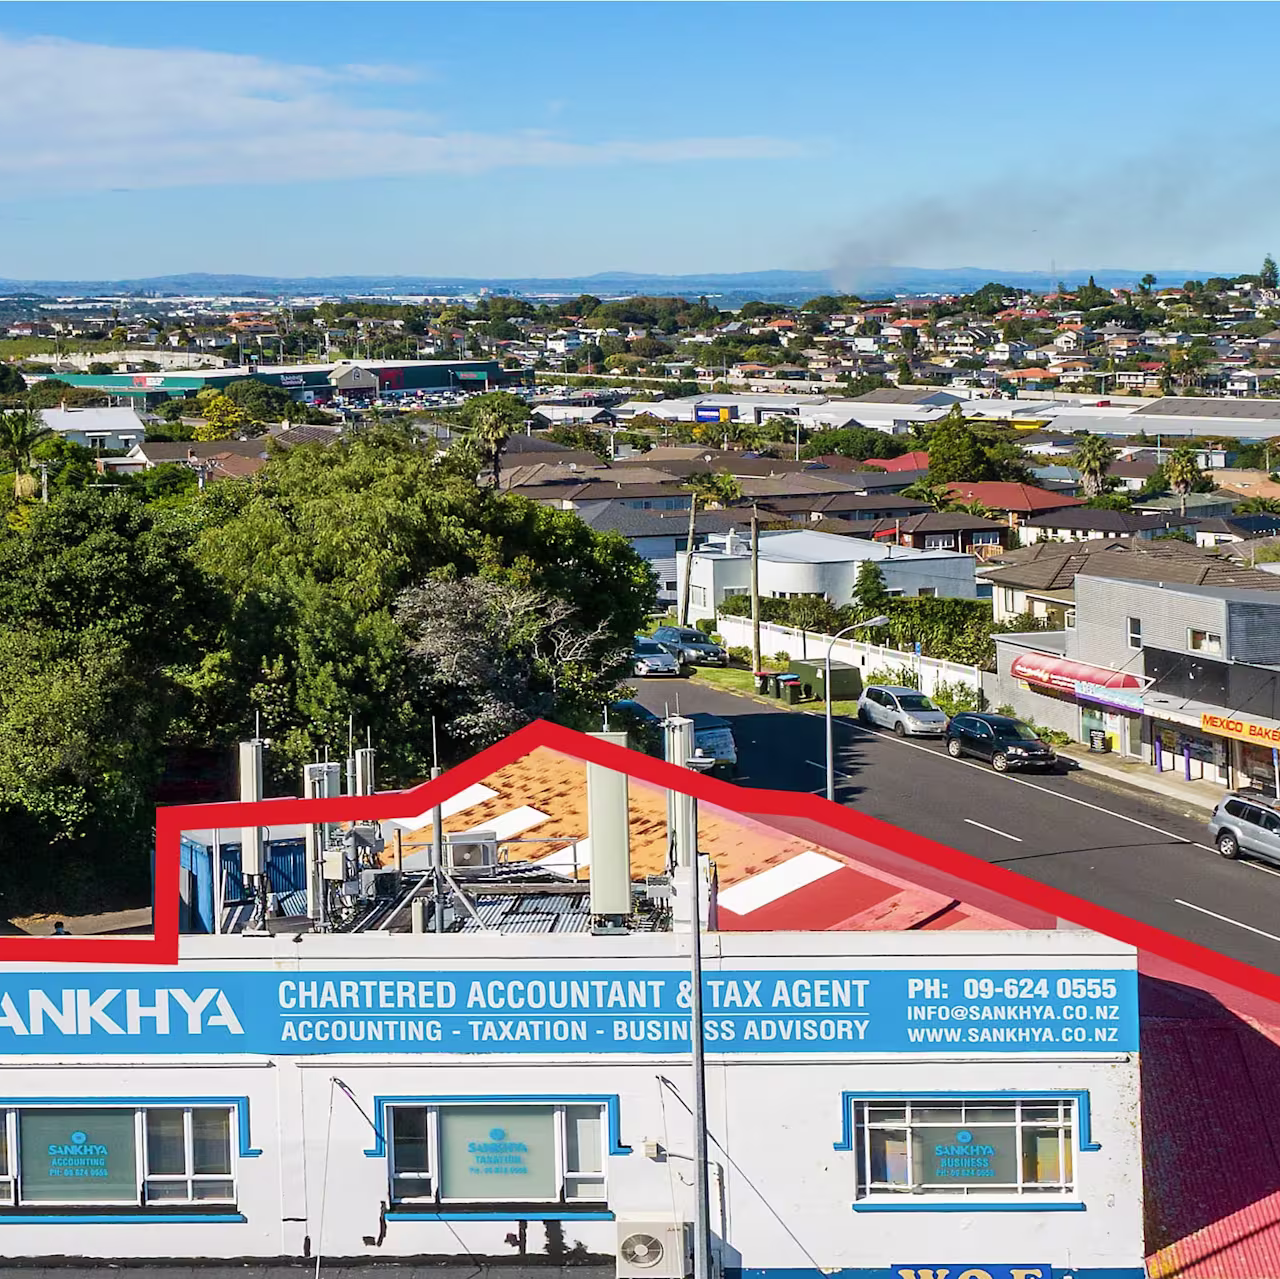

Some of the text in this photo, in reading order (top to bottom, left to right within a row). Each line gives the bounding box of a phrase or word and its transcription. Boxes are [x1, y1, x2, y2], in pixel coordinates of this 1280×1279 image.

[1202, 714, 1243, 733] MEXICO
[278, 979, 870, 1009] CHARTERED ACCOUNTANT & TAX AGENT
[907, 977, 1117, 999] PH: 09-624 0555
[907, 1004, 1120, 1021] INFO@SANKHYA.CO.NZ
[281, 1020, 442, 1041] ACCOUNTING
[468, 1020, 587, 1041] TAXATION
[613, 1020, 736, 1041] BUSINSS
[743, 1019, 870, 1041] ADVISORY
[907, 1026, 1119, 1043] WWW.SANKHYA.CO.NZ
